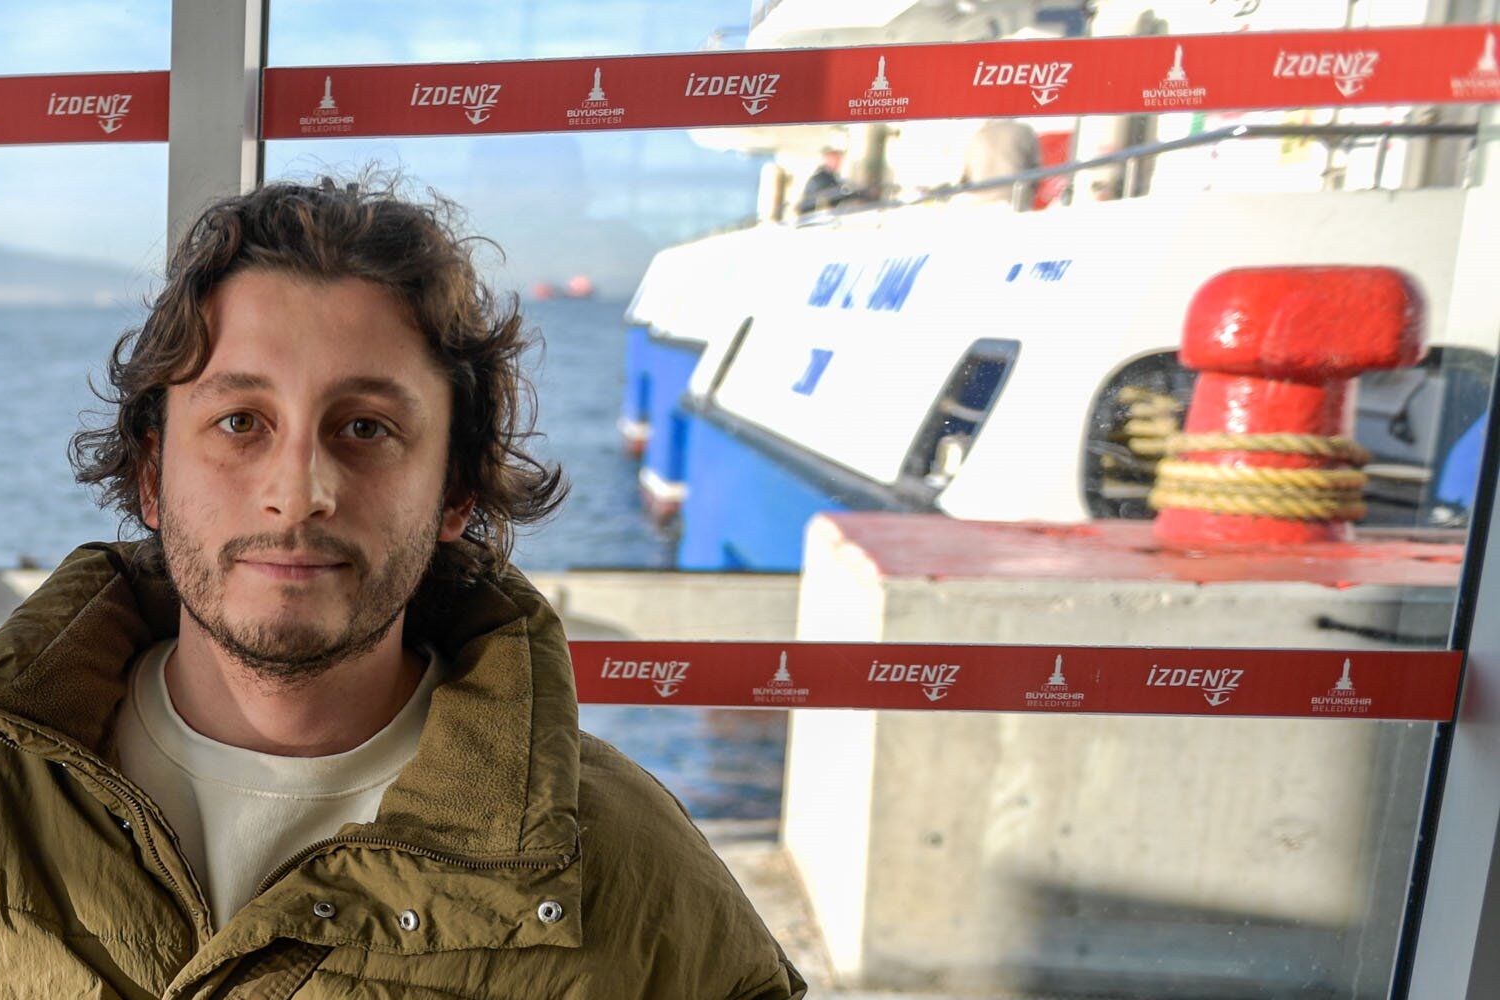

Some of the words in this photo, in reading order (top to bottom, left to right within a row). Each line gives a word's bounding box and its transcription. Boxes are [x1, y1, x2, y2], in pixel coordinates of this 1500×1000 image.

[972, 60, 1073, 96] İZDENİZ
[1272, 49, 1379, 87] İZDENİZ
[410, 82, 502, 115] İZDENİZ
[684, 71, 781, 106] İZDENİZ
[47, 92, 133, 125] İZDENİZ
[600, 656, 690, 687] İZDENİZ
[867, 660, 962, 691] İZDENİZ
[1145, 663, 1244, 695] İZDENİZ
